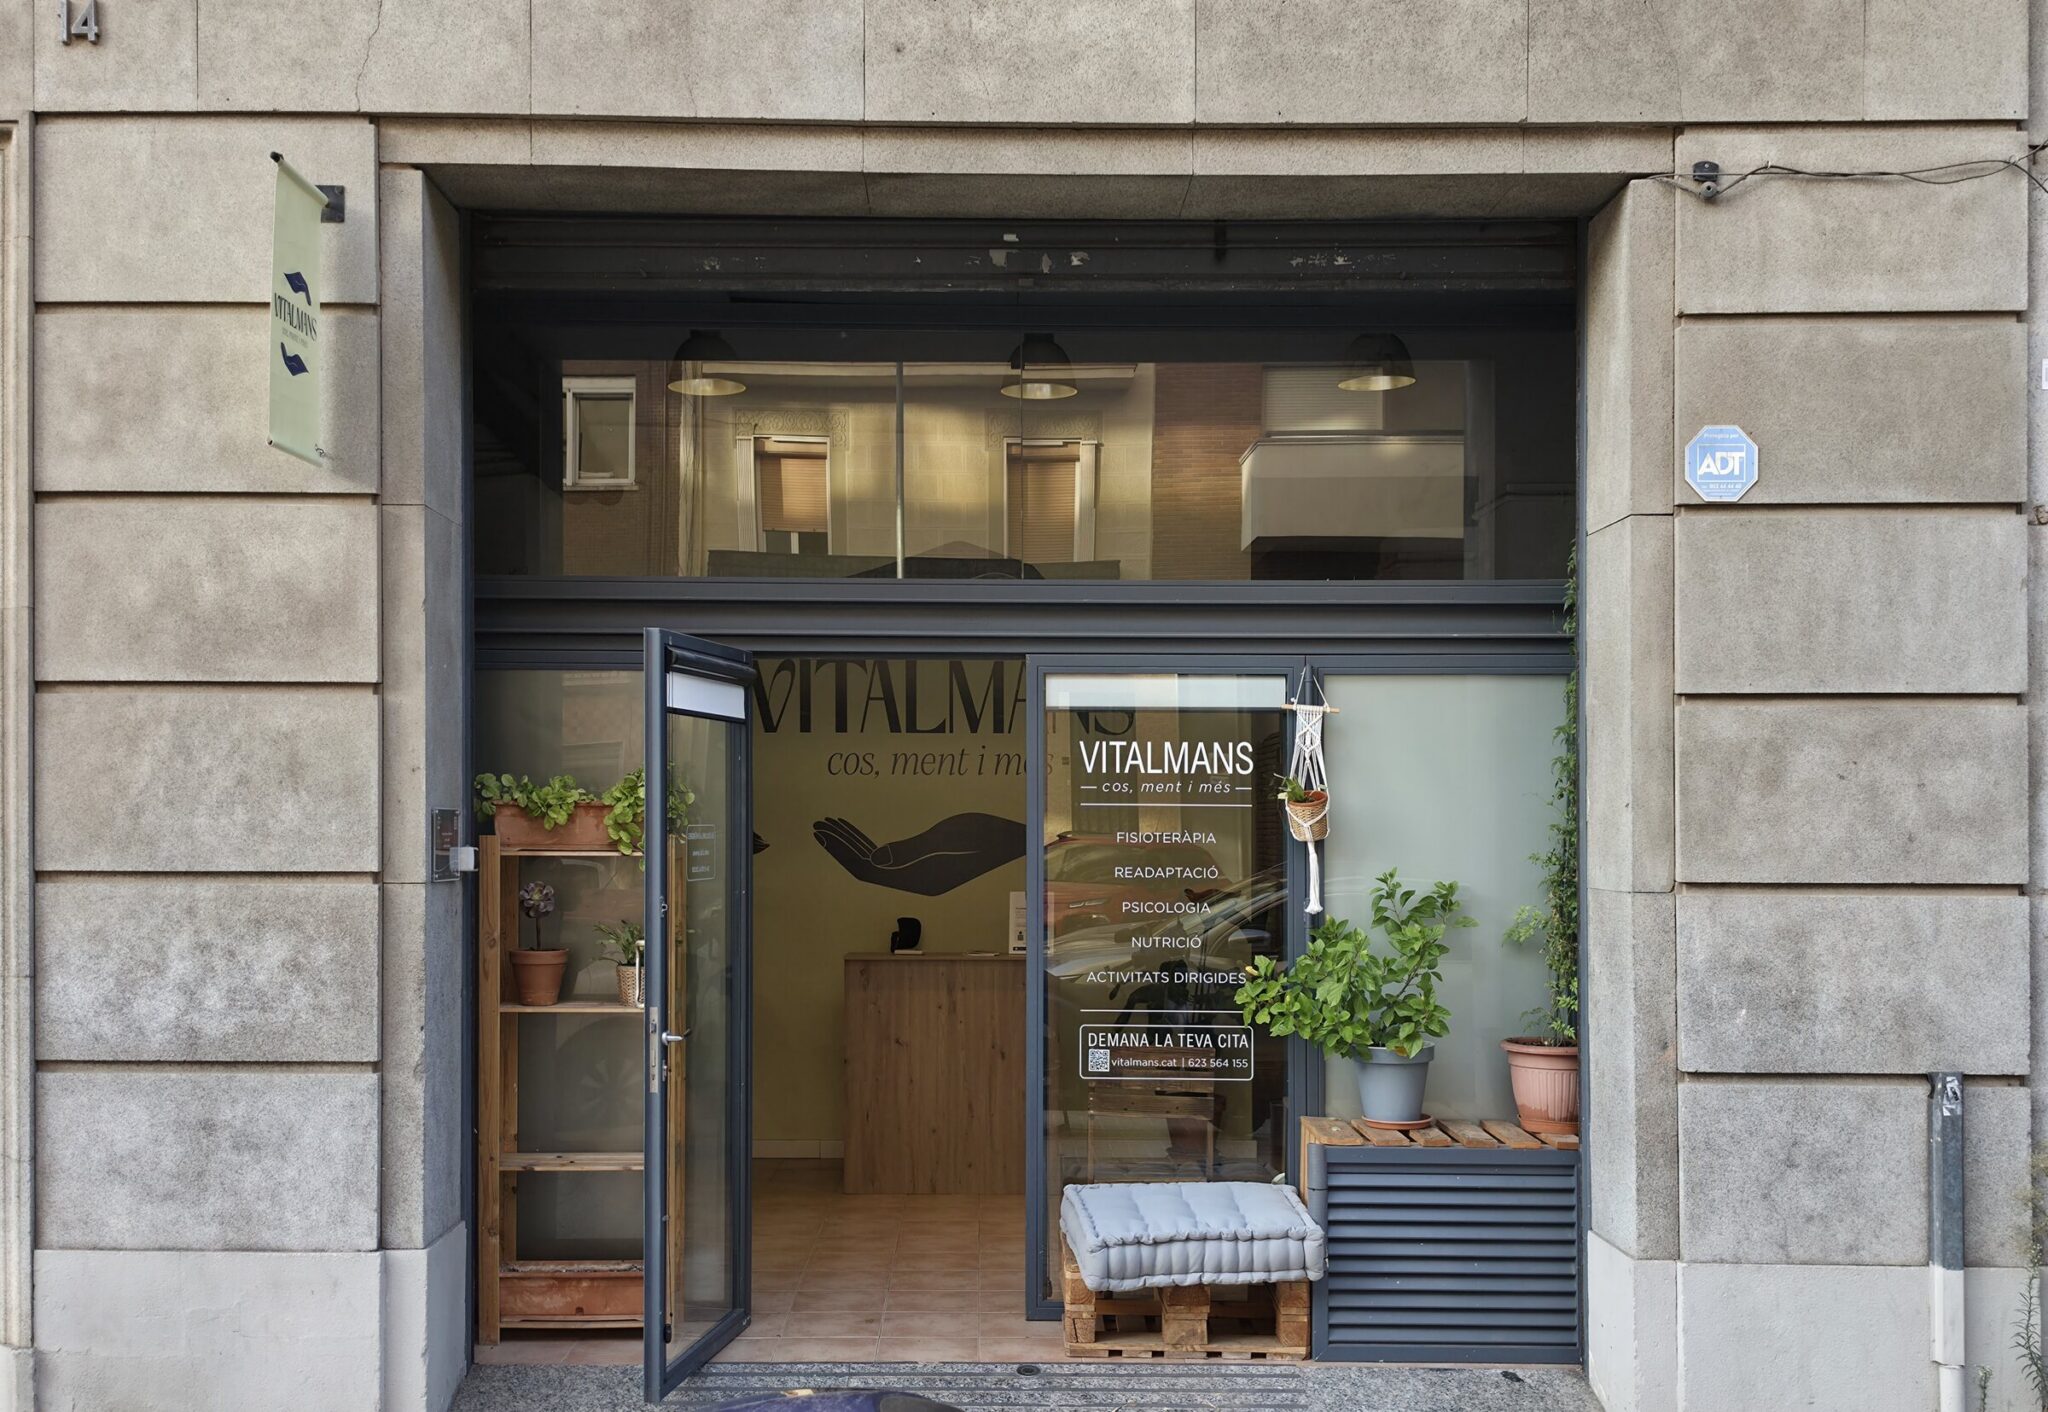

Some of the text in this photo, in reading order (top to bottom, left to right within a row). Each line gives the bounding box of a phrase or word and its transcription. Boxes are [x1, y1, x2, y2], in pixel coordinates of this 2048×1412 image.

[58, 0, 99, 45] 14
[274, 292, 317, 341] VITALMANS
[1698, 451, 1745, 475] ADT
[827, 751, 880, 778] cos,
[891, 748, 968, 775] ment
[977, 745, 986, 775] i
[1080, 740, 1254, 775] VITALMANS
[1102, 780, 1231, 794] cos, ment i més
[1116, 829, 1217, 844] FISIOTERÀPIA
[1114, 865, 1219, 879] READAPTACIÓ
[1122, 901, 1212, 914] PSICOLOGIA
[1131, 934, 1202, 949] NUTRICIÓ
[1086, 971, 1247, 984] ACTIVITATS DIRIGIDES
[1088, 1032, 1249, 1048] DEMANA LA TEVA CITA
[1111, 1057, 1249, 1068] vitalmans.cat 623 564 155
